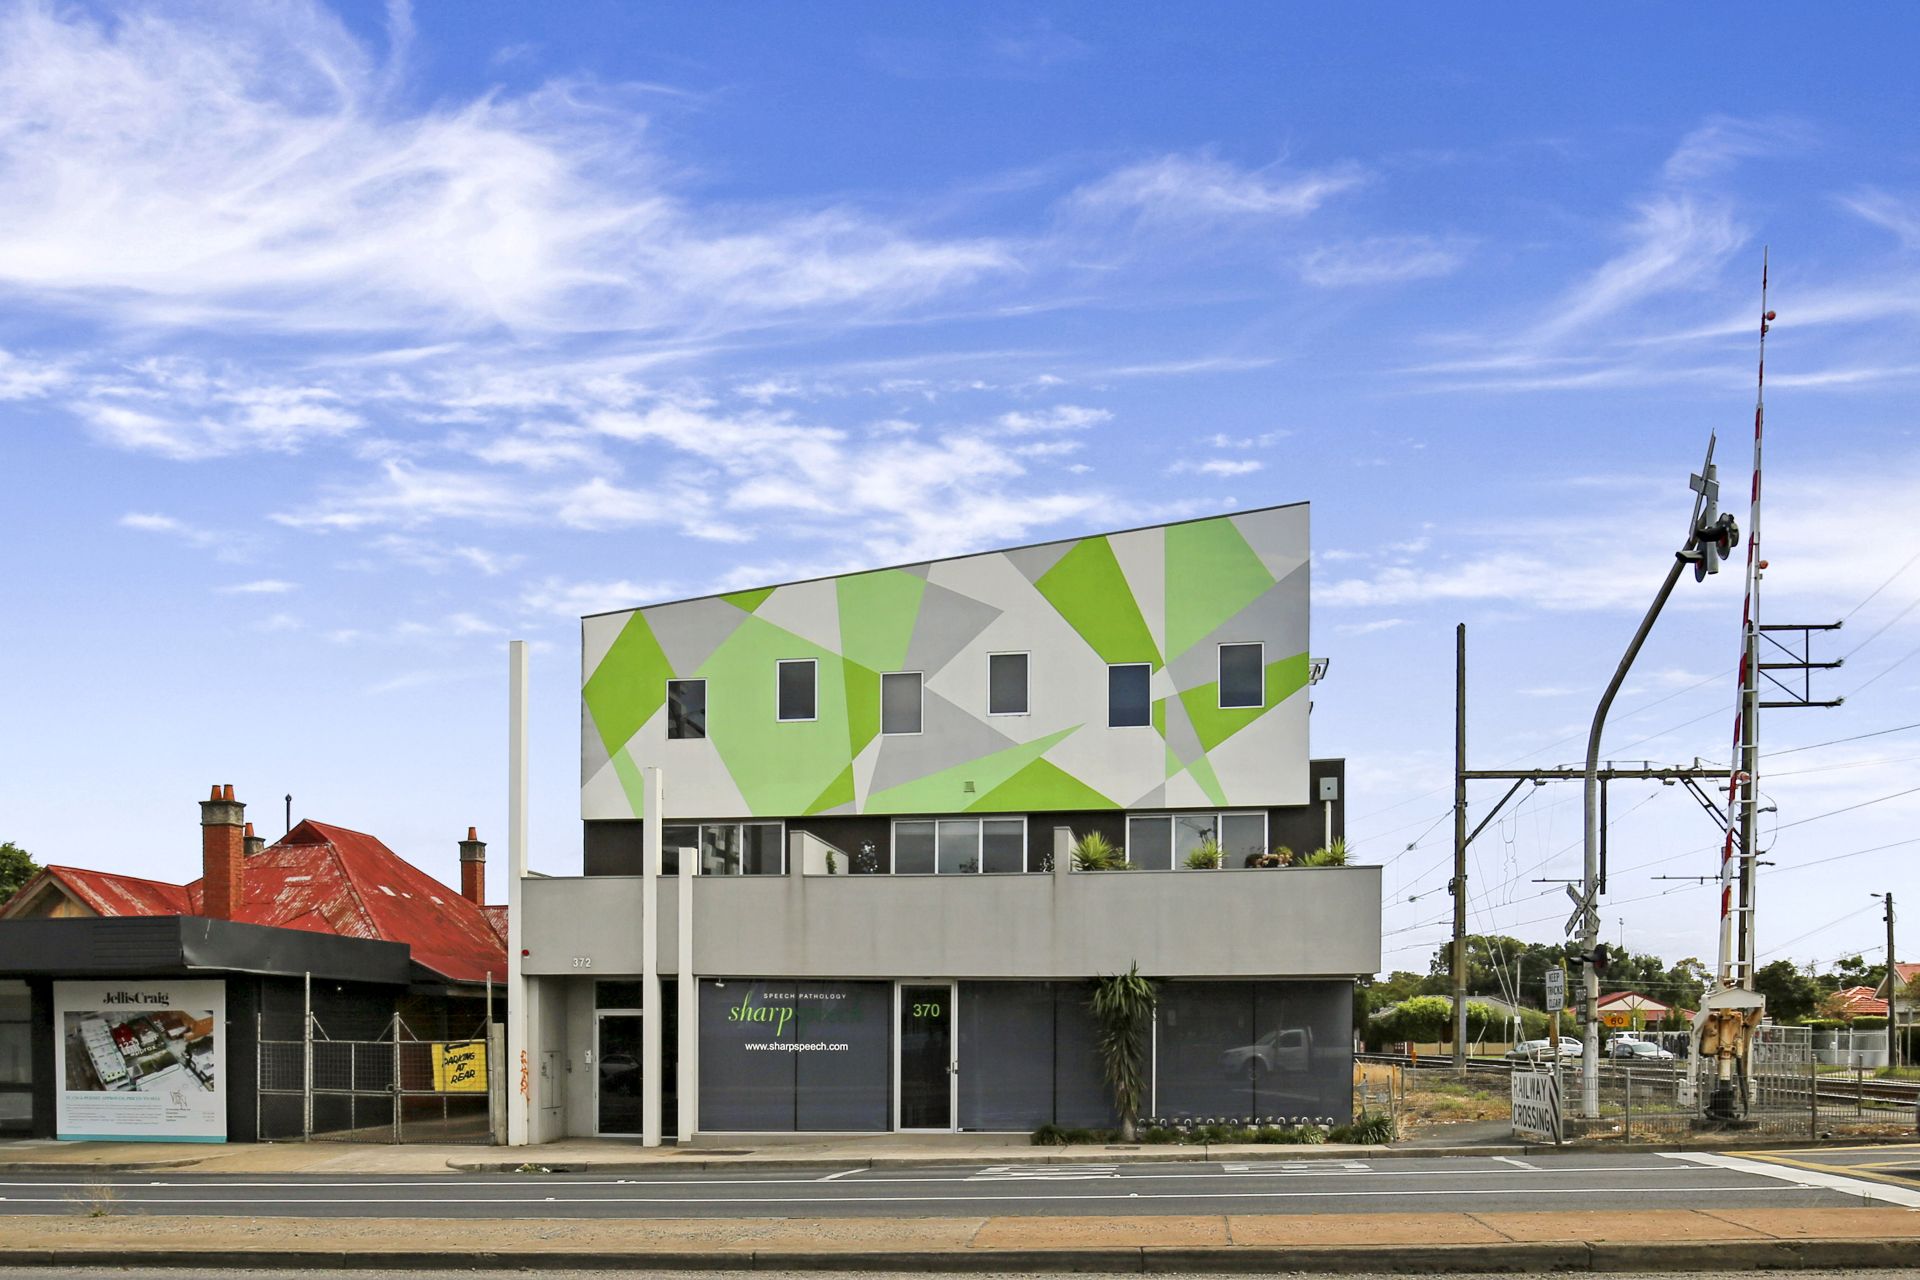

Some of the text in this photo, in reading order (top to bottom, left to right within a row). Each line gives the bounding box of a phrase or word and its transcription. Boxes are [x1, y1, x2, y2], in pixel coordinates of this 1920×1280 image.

[573, 957, 591, 968] 372
[103, 991, 170, 1007] JellisCraig
[728, 990, 793, 1037] sharp
[913, 1003, 940, 1017] 370
[1610, 1017, 1624, 1025] 60
[745, 1042, 849, 1052] www.sharpspeech.com
[441, 1052, 476, 1068] PARKING
[456, 1062, 468, 1072] AT
[450, 1069, 476, 1084] REAR
[1513, 1076, 1547, 1102] RAILWAY
[1513, 1103, 1550, 1132] CROSSING
